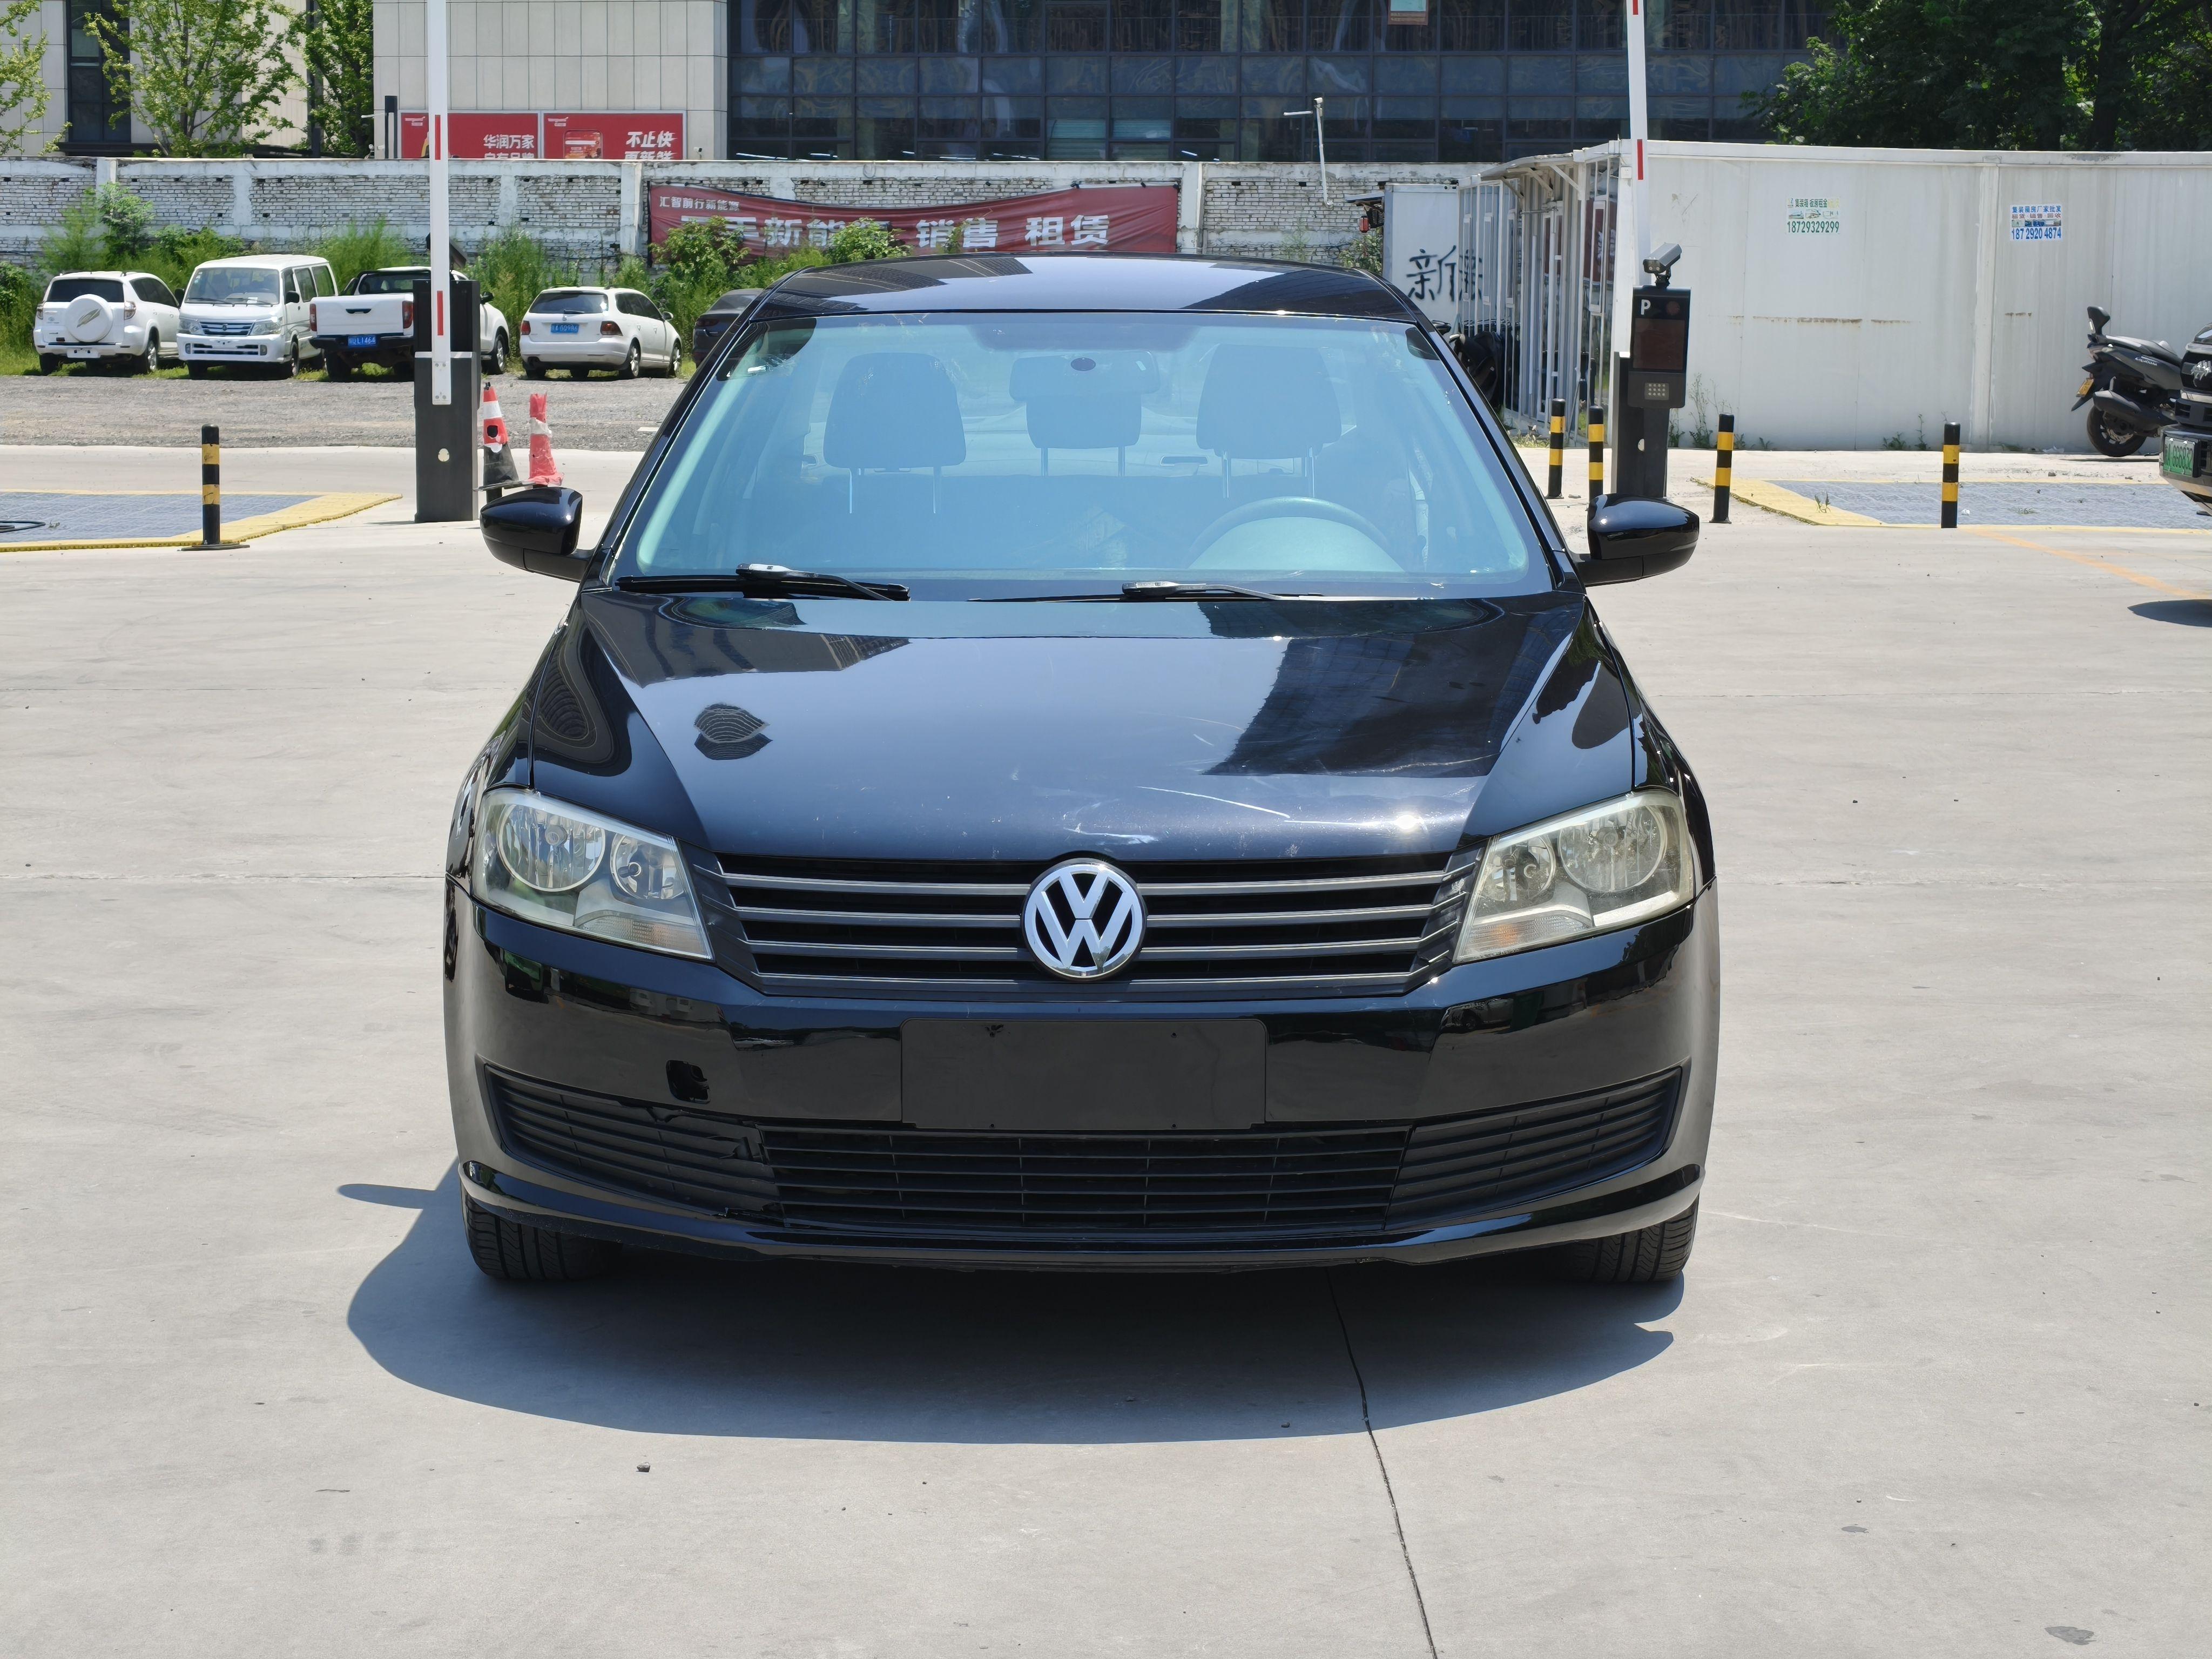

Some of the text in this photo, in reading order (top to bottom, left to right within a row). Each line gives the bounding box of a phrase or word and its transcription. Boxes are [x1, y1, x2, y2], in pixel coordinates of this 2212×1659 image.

[483, 134, 535, 149] 华润万家
[625, 130, 678, 147] 不止快
[659, 195, 740, 211] 汇智前行新能源
[916, 217, 998, 248] 销售
[1025, 214, 1109, 246] 租赁
[1787, 220, 1839, 233] 18729329299
[2012, 227, 2061, 239] 187 2920 4874
[1641, 299, 1651, 315] P
